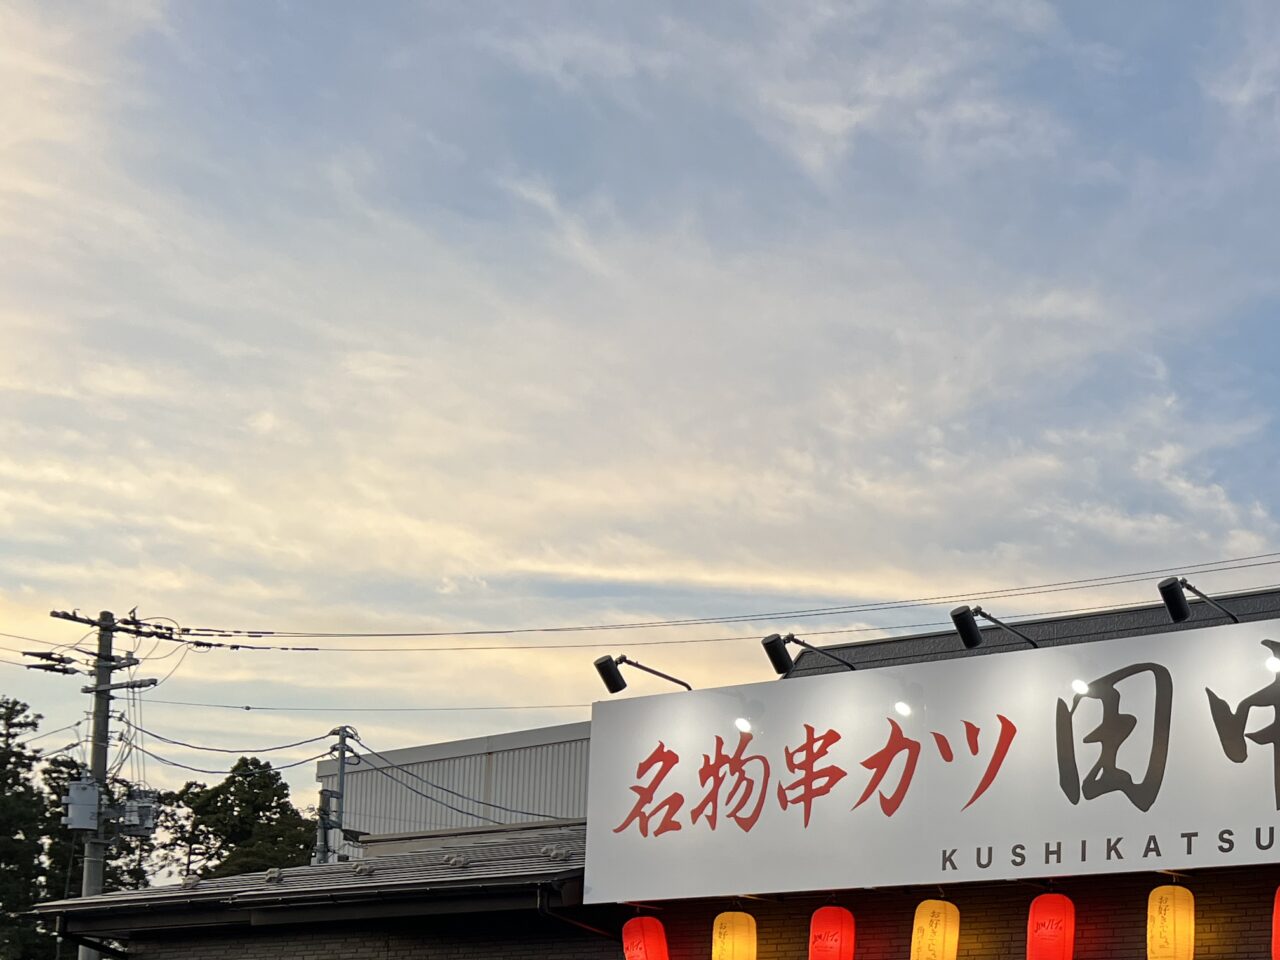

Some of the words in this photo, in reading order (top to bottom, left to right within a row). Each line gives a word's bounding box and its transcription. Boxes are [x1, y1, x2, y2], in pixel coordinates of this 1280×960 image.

[612, 713, 1017, 840] 名物串カツ
[941, 826, 1277, 872] KUSHIKATSU
